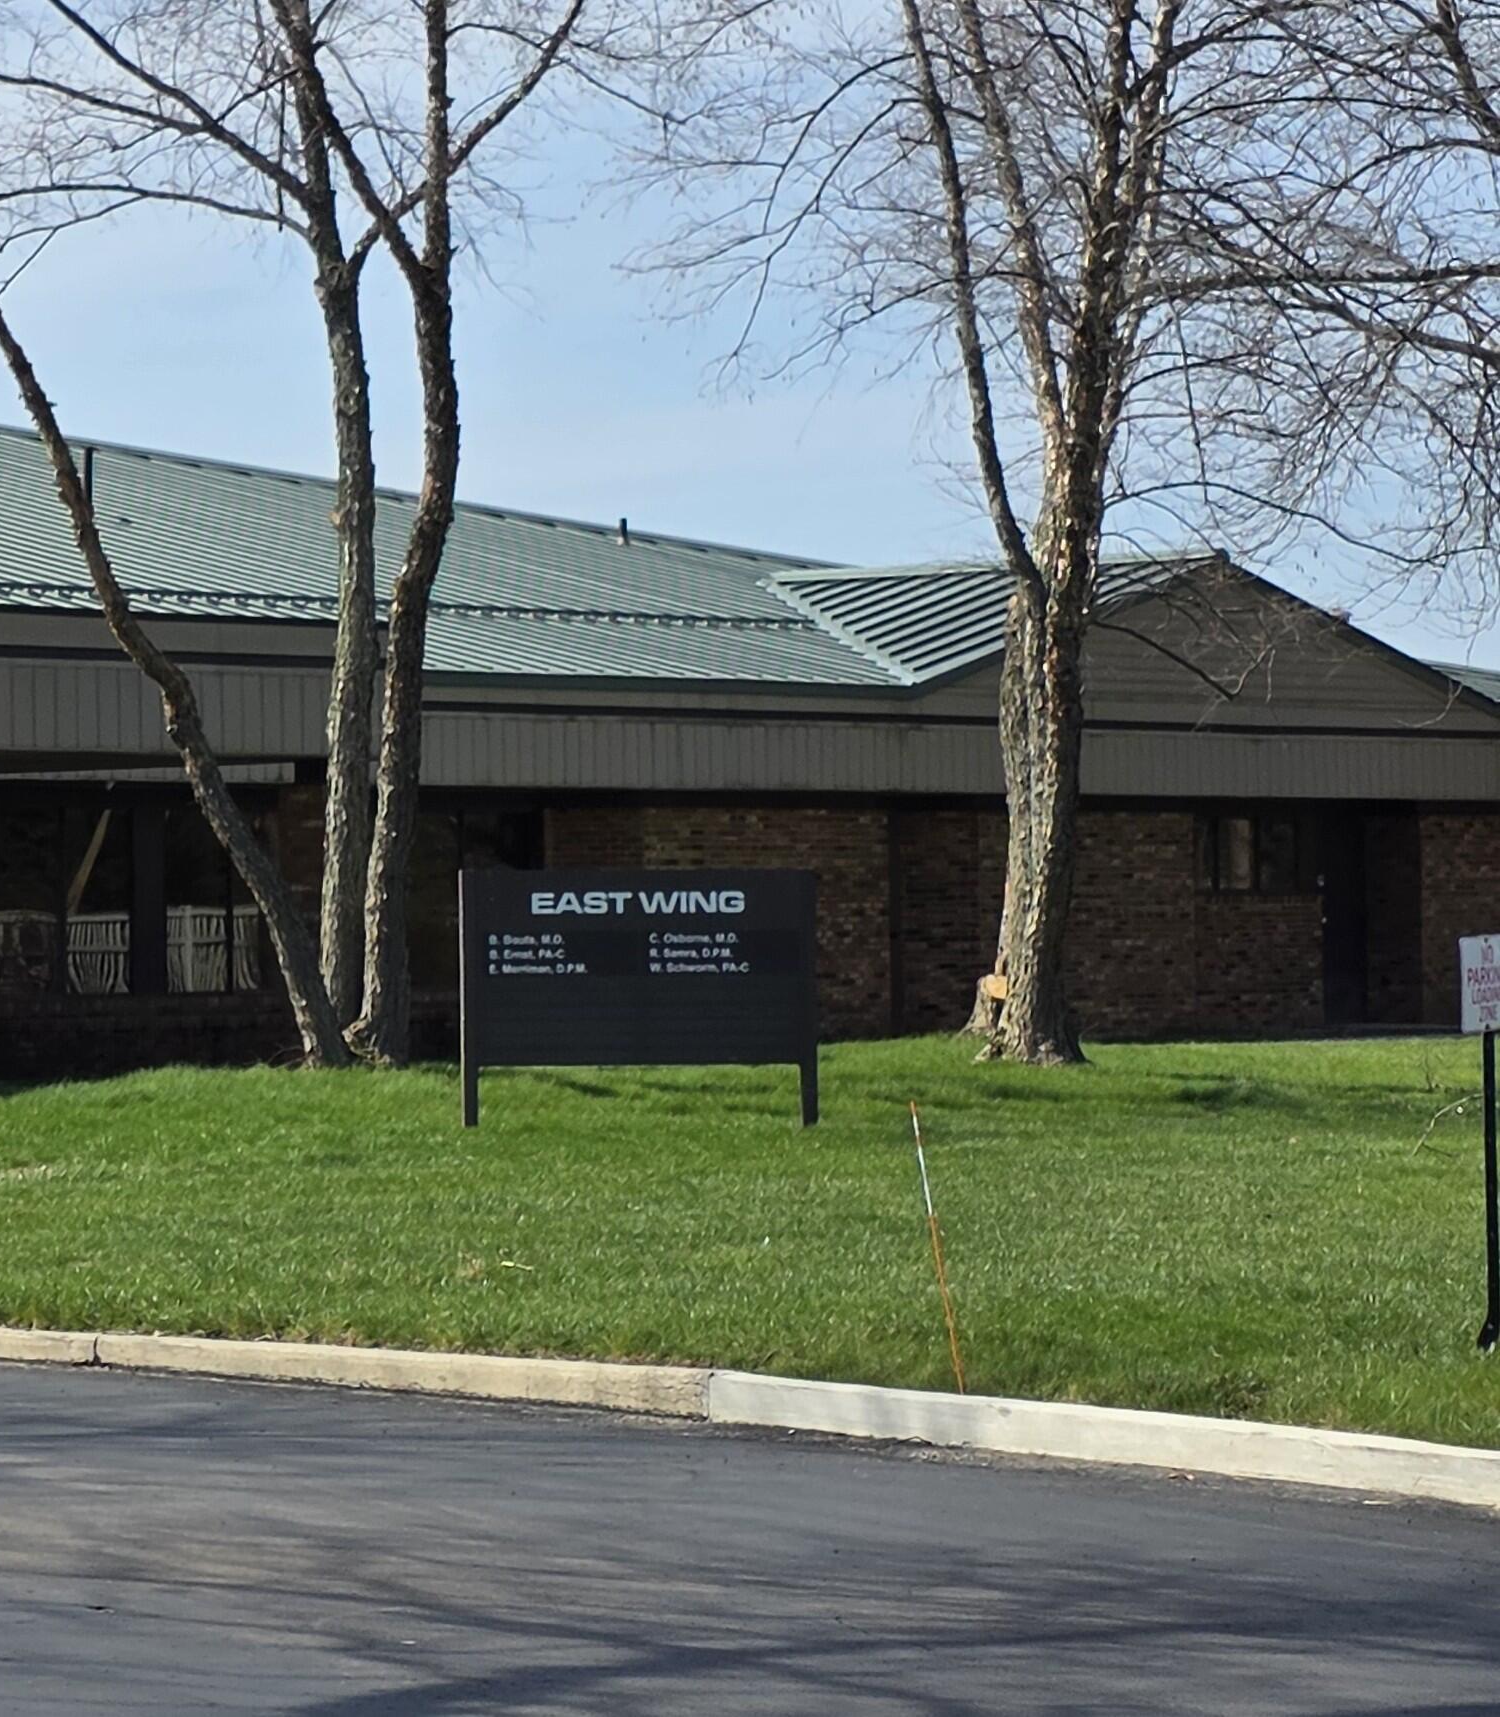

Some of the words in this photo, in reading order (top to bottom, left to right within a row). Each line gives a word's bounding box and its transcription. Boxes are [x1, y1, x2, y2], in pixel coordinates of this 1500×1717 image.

[531, 891, 633, 915] EAST
[638, 890, 746, 914] WING
[649, 932, 661, 945] C.
[538, 948, 565, 960] PA-C
[1481, 945, 1494, 964] NO
[556, 963, 588, 975] D.P.M.
[649, 962, 665, 973] W.
[722, 961, 751, 974] PA-C
[1467, 966, 1500, 987] PARKIN
[1471, 986, 1500, 1006] LOADIN
[1479, 1004, 1499, 1022] ZONE
